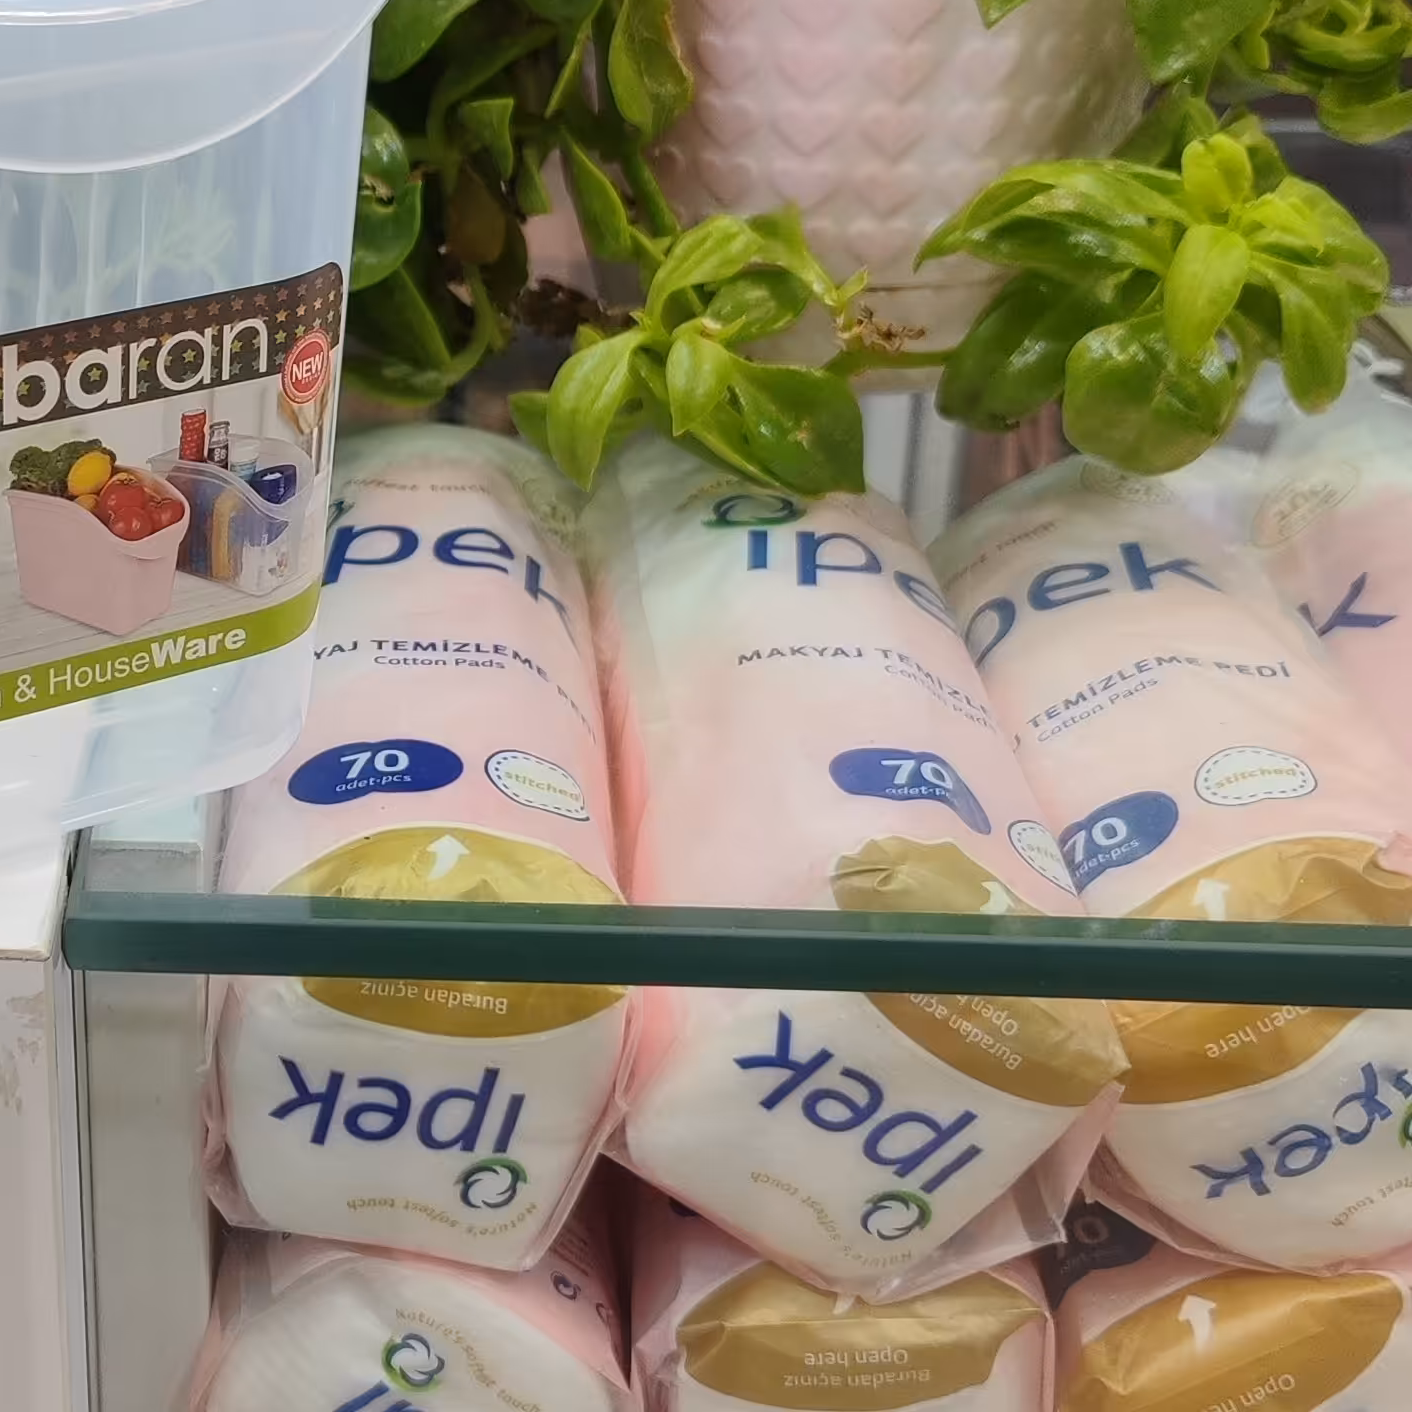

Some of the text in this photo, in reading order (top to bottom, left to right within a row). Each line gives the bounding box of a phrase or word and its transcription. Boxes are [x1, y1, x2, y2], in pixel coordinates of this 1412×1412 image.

[2, 318, 269, 425] baran
[292, 351, 324, 383] NEW
[14, 674, 37, 702] &
[49, 627, 247, 695] HouseWare
[374, 655, 506, 669] Cotton Pads
[737, 645, 864, 666] MAKYAJ
[1026, 654, 1204, 729] TEMİZLEME
[1037, 675, 1159, 742] Cotton Pads
[340, 749, 410, 780] 70
[881, 759, 953, 790] 70
[1214, 767, 1298, 790] stitched
[503, 768, 580, 803] stitched
[424, 986, 508, 1015] Buradan
[948, 1014, 1023, 1071] Buradan
[1204, 1026, 1260, 1059] here
[750, 1171, 800, 1197] touch
[346, 1197, 395, 1210] touch
[804, 1346, 909, 1368] Open here
[847, 1368, 931, 1390] Buradan
[1239, 1373, 1296, 1407] Open
